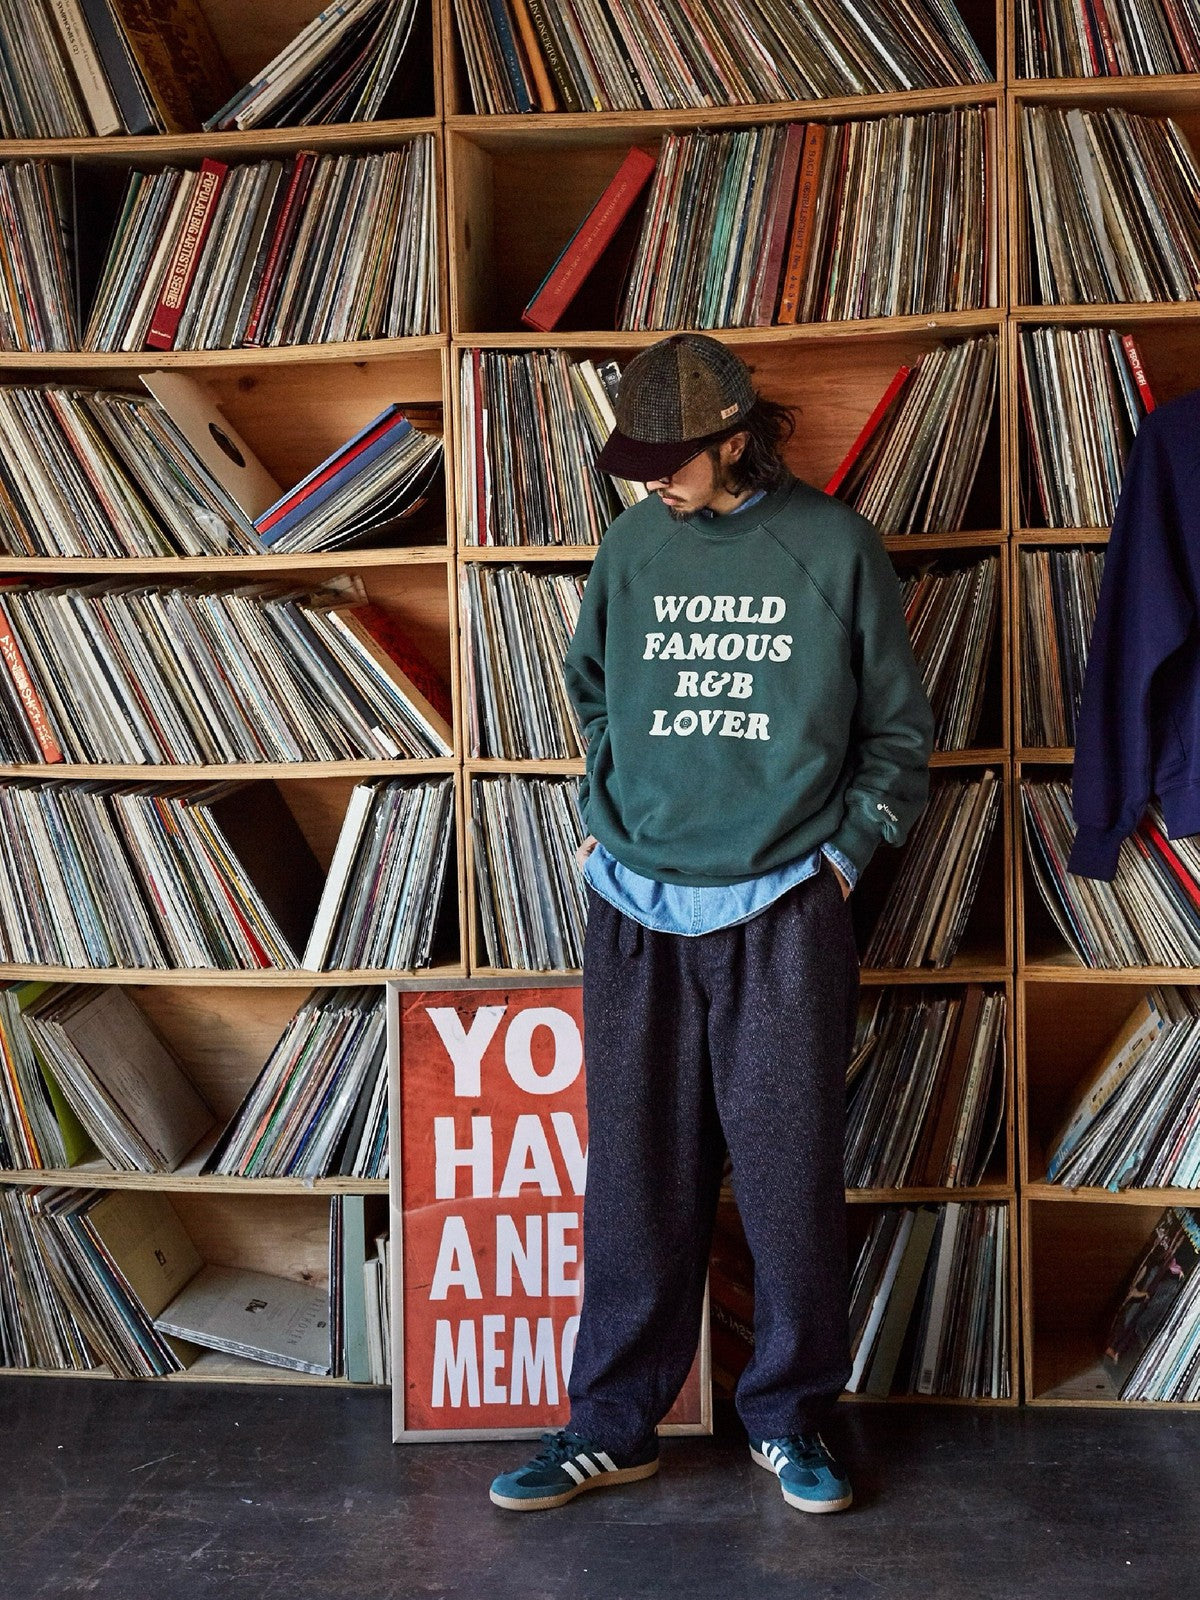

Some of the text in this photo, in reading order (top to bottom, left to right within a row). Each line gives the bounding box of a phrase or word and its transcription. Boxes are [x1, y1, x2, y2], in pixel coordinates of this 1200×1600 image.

[535, 14, 558, 65] CONCERTOS
[806, 151, 816, 177] BACH
[165, 171, 215, 309] POPULAR BIG ARTISTS SERIES
[1128, 348, 1141, 369] PERCY
[653, 595, 787, 624] WORLD
[643, 632, 793, 662] FAMOUS
[674, 670, 754, 699] R&B
[649, 709, 771, 740] LOVER
[426, 1005, 583, 1098] YO
[433, 1111, 587, 1200] HAV
[429, 1211, 584, 1301] A NE
